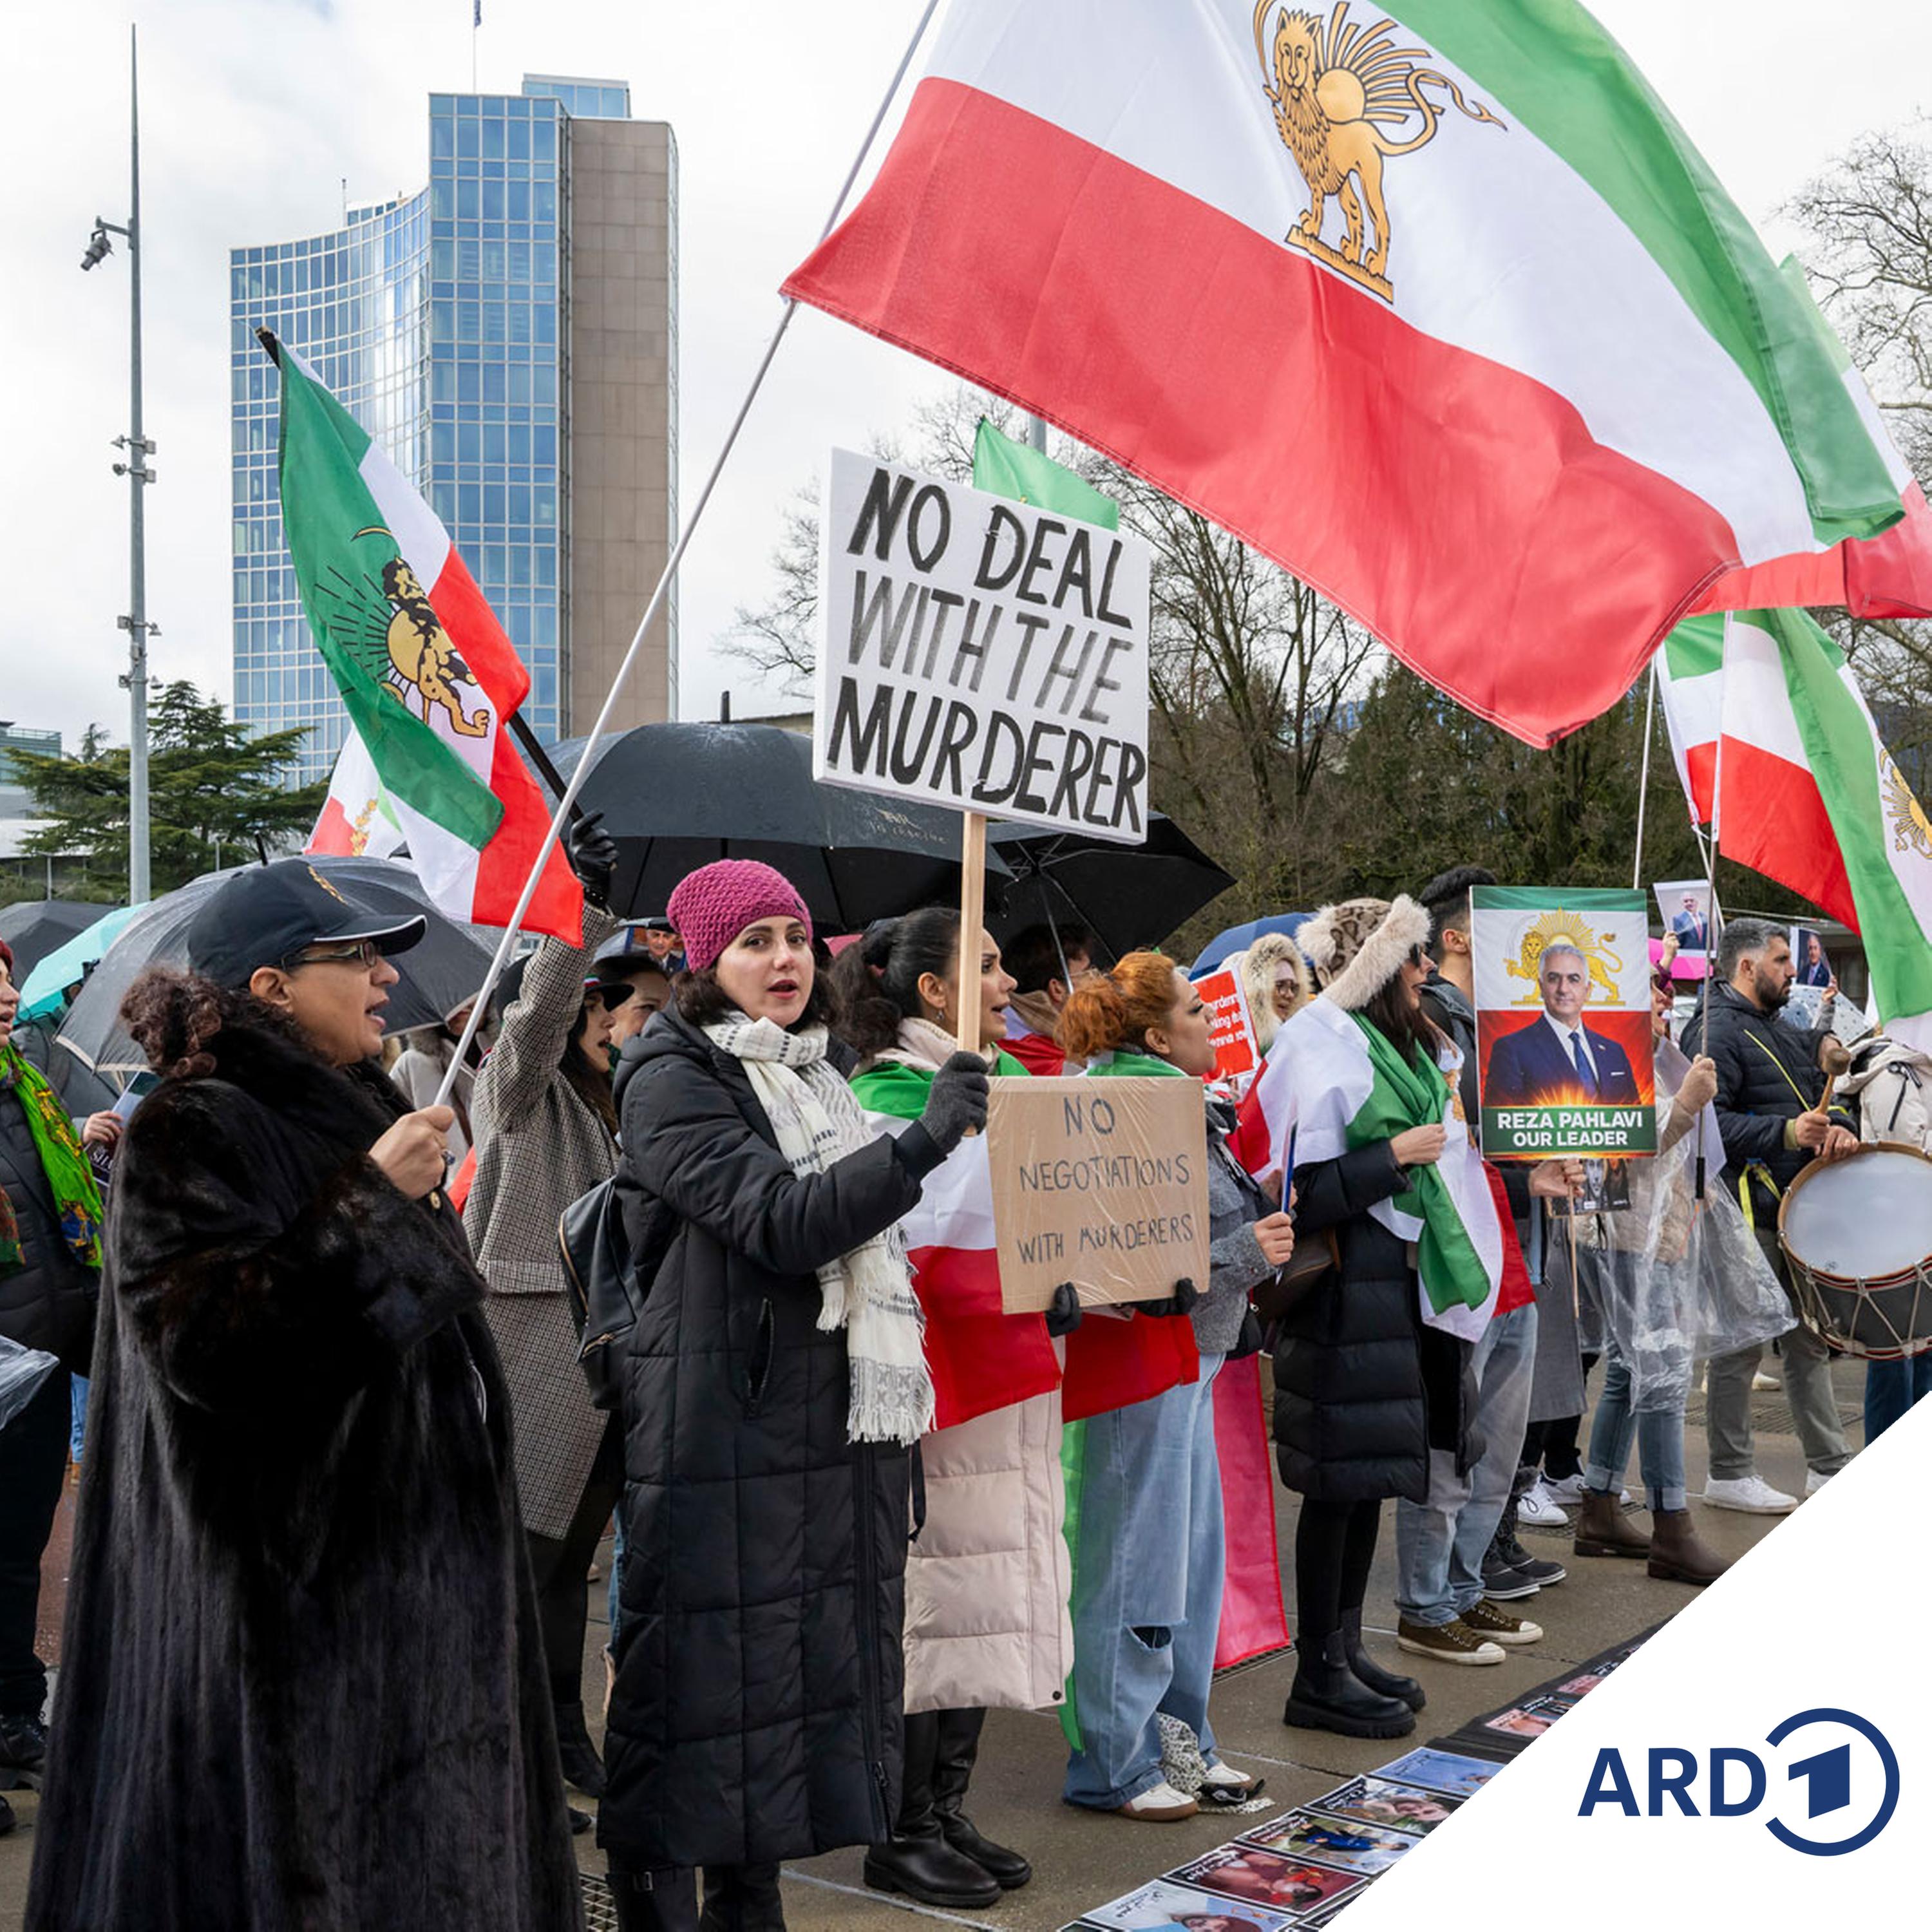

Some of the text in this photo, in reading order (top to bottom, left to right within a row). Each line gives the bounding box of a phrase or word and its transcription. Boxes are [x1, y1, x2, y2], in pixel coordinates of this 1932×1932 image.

[847, 468, 1133, 629] NO DEAL
[848, 569, 1134, 724] WITH THE
[827, 676, 1146, 833] MURDERER
[1064, 1097, 1115, 1135] NO
[1497, 1112, 1642, 1128] REZA PAHLAVI
[1513, 1131, 1627, 1146] OUR LEADER
[1019, 1154, 1190, 1192] NEGOTIATIONS
[1018, 1213, 1193, 1264] WITH MURDERERS
